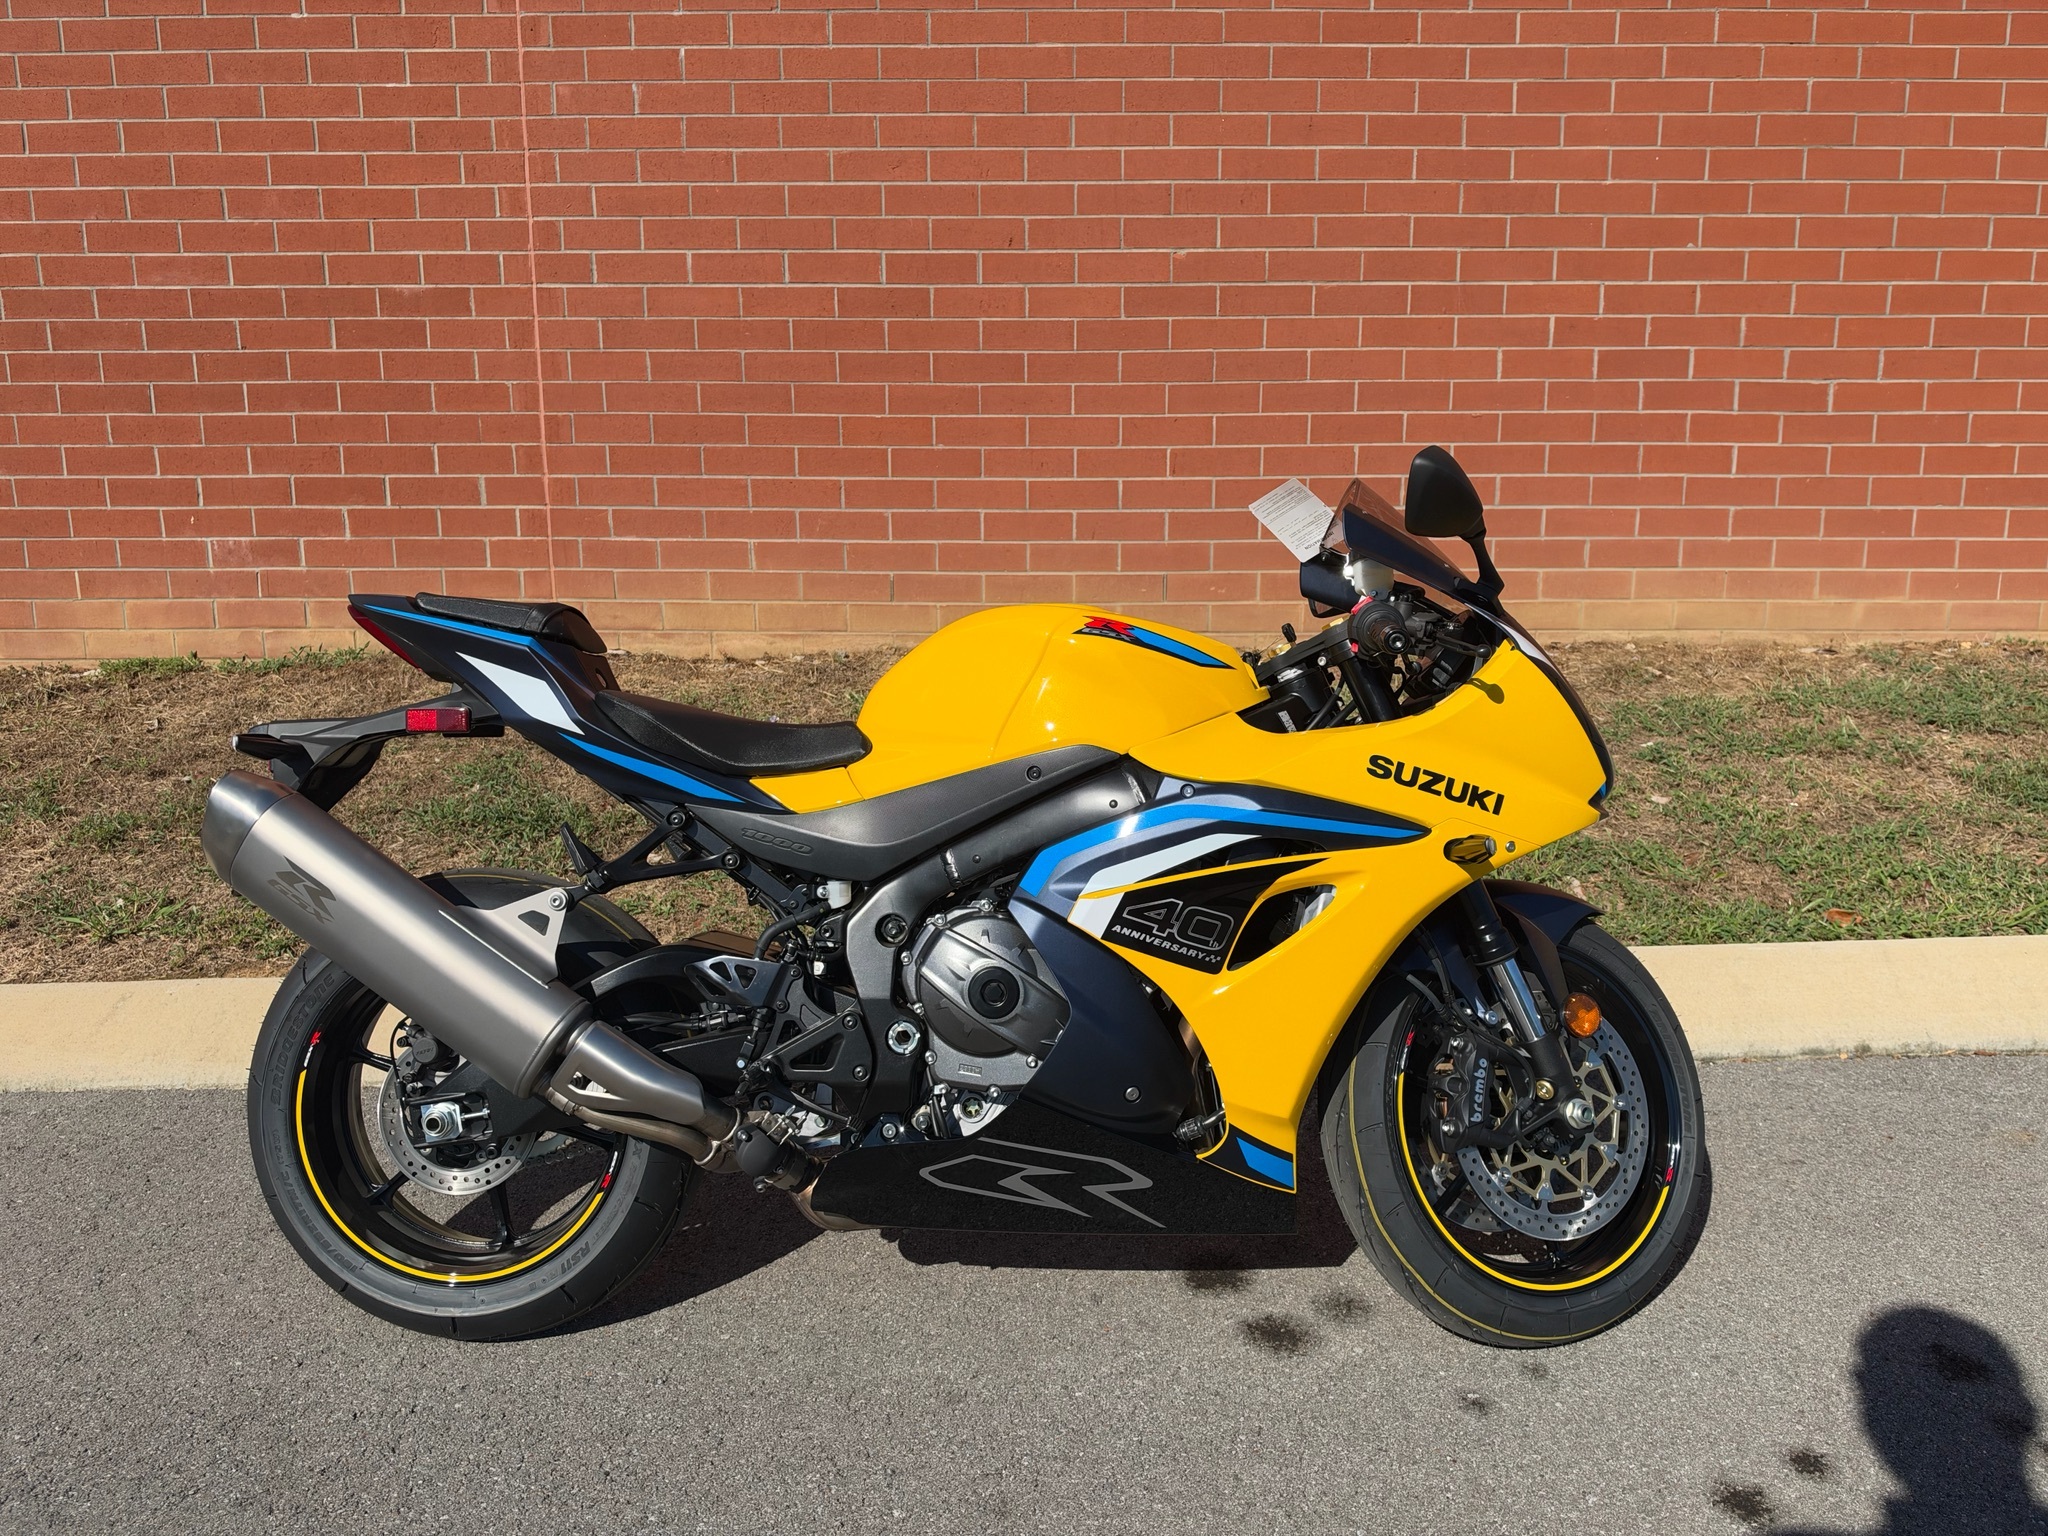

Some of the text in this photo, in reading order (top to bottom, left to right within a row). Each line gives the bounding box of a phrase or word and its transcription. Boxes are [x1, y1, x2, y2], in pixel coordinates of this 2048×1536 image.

[1366, 754, 1505, 816] SUZUKI
[741, 827, 814, 856] 1000
[1111, 923, 1206, 960] ANNIVERSARY
[270, 972, 335, 1107] BRIDGESTONE
[1470, 1058, 1488, 1122] brembo
[1650, 1008, 1693, 1136] BRIDGESTONE
